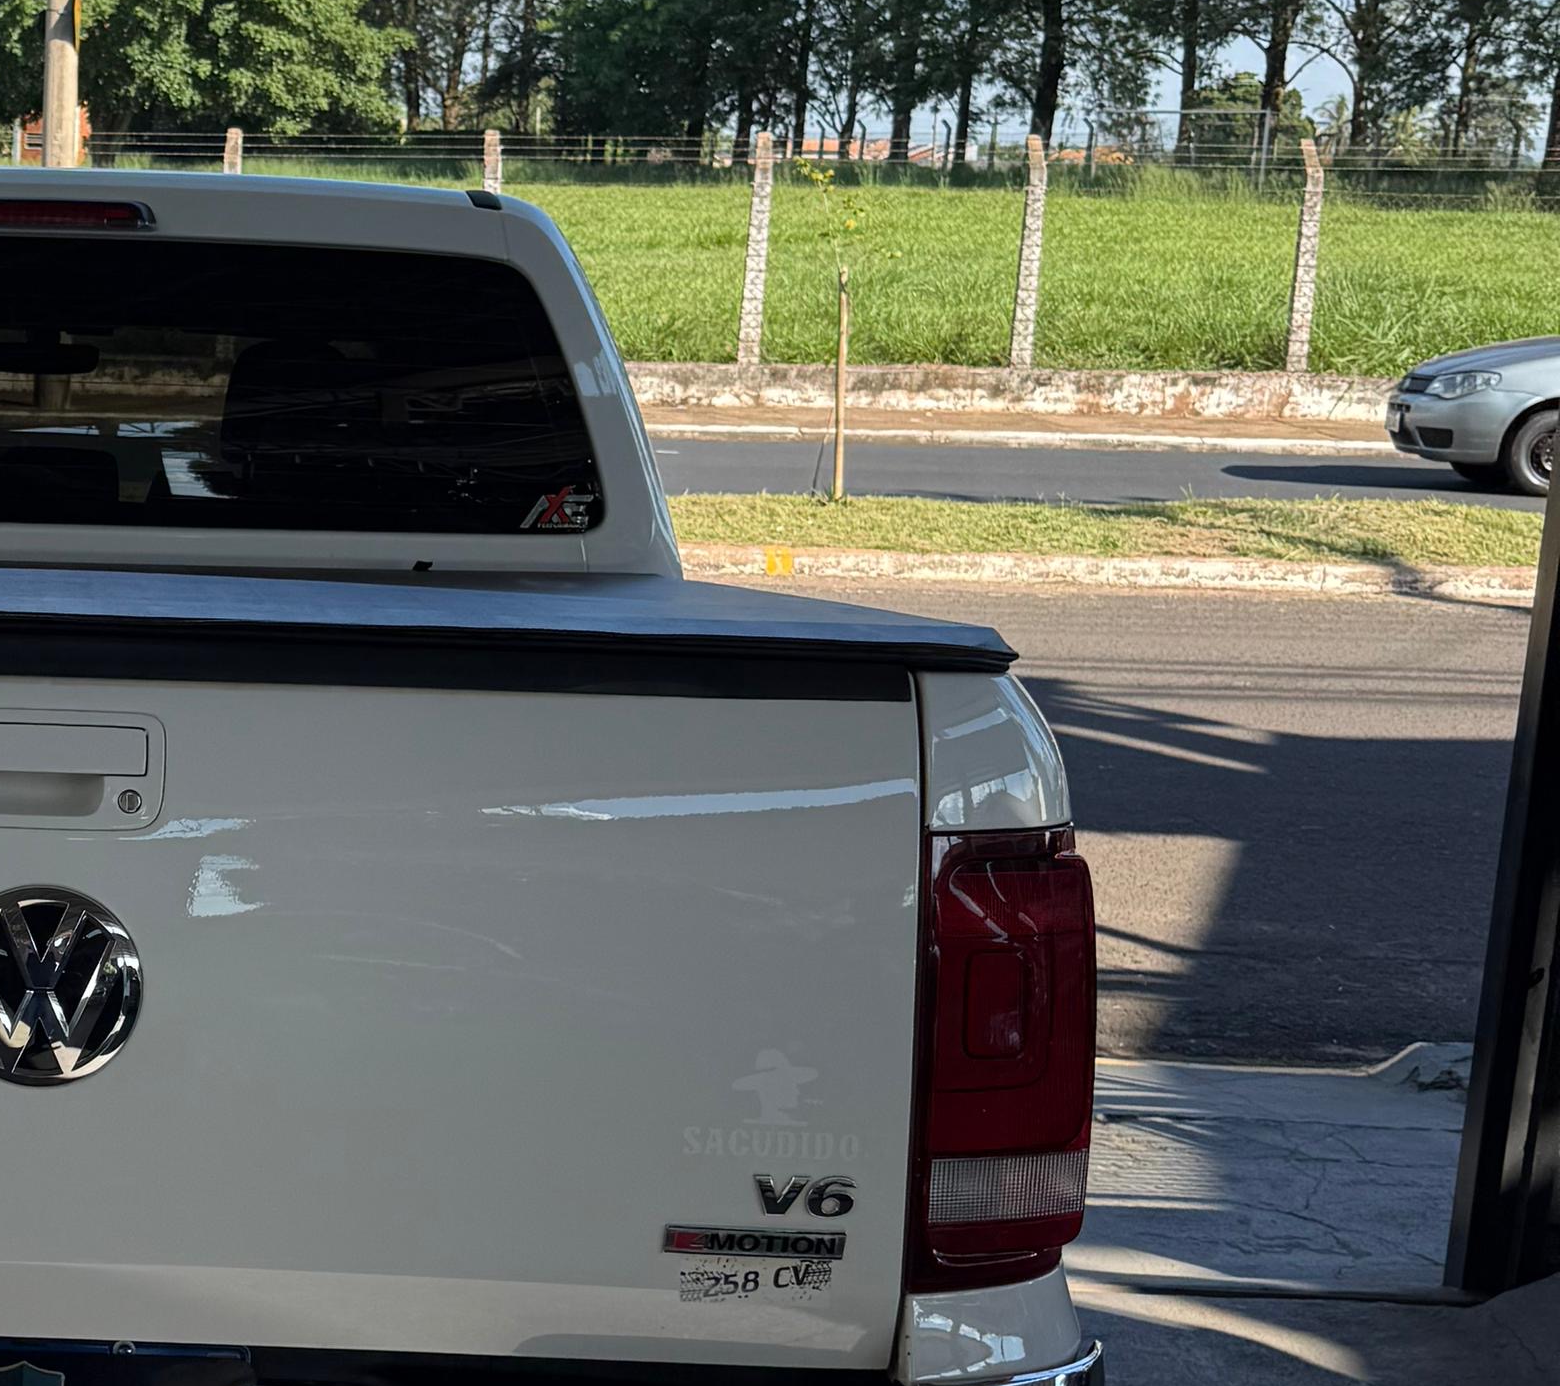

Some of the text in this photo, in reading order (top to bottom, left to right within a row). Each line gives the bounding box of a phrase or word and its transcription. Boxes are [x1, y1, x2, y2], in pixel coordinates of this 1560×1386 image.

[682, 1125, 860, 1161] SACUDIDO
[753, 1174, 857, 1218] V6
[702, 1266, 810, 1298] 258 CV
